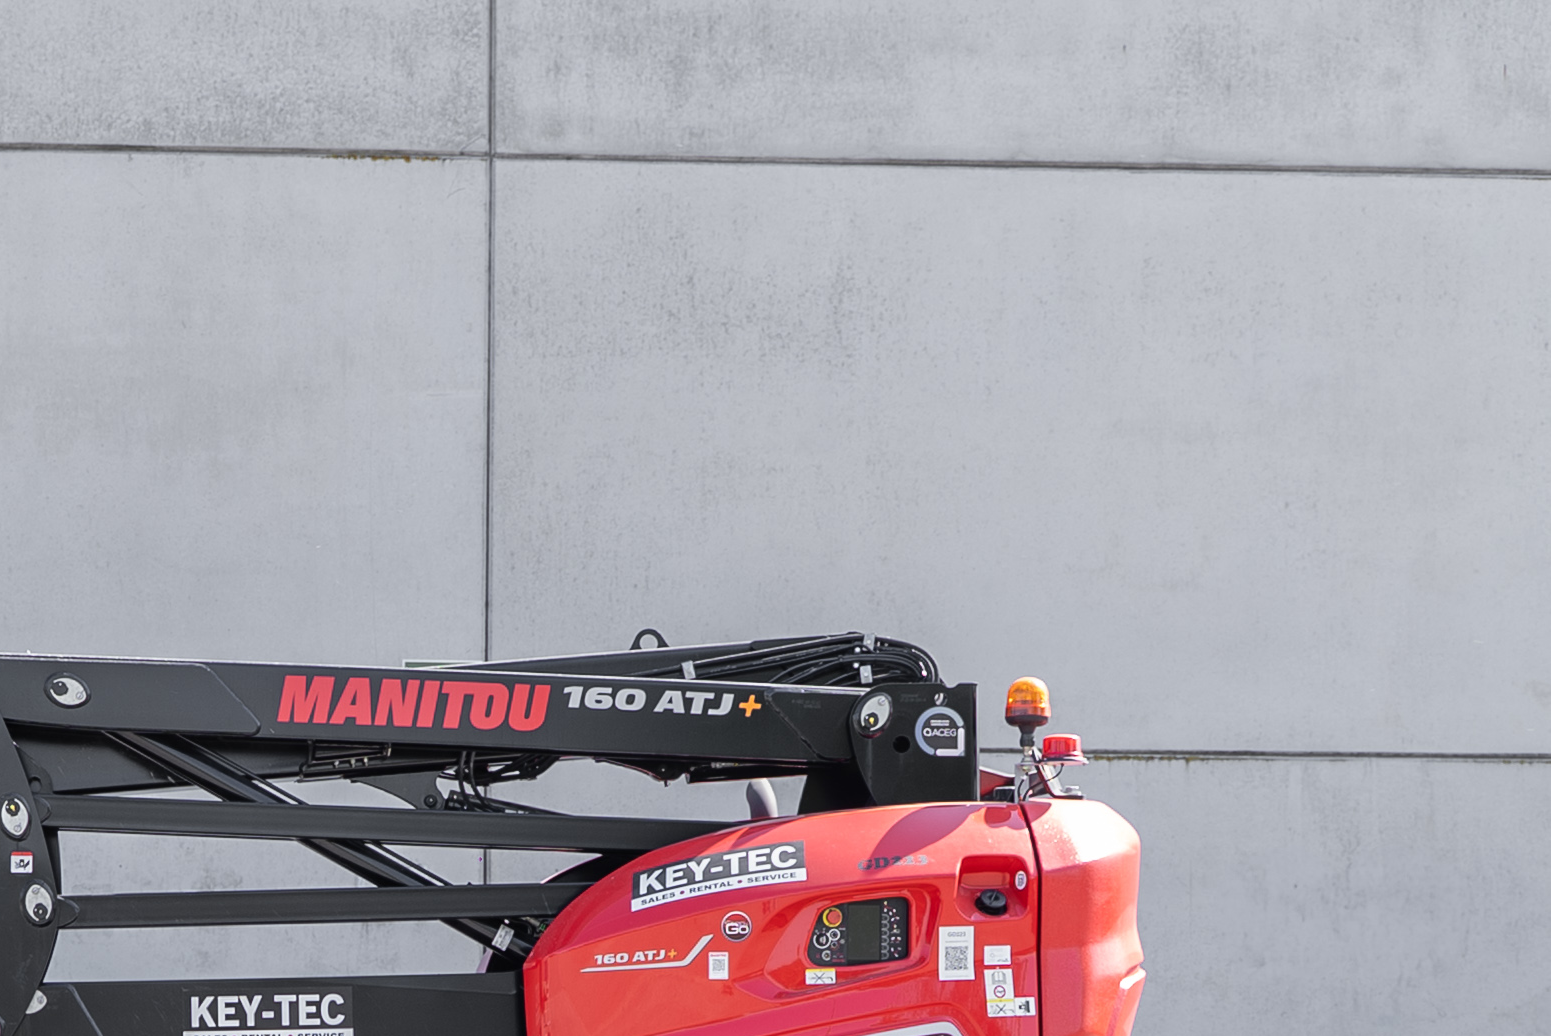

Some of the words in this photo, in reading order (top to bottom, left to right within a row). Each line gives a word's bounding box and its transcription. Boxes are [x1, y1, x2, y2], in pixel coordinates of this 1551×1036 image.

[276, 674, 551, 732] MANITOU
[563, 685, 647, 712] 160
[638, 845, 798, 896] KEY-TEC
[640, 891, 676, 906] SALES
[688, 880, 734, 895] RENTAL
[746, 872, 797, 884] SERVICE
[594, 952, 629, 965] 160
[190, 993, 346, 1028] KEY-TEC
